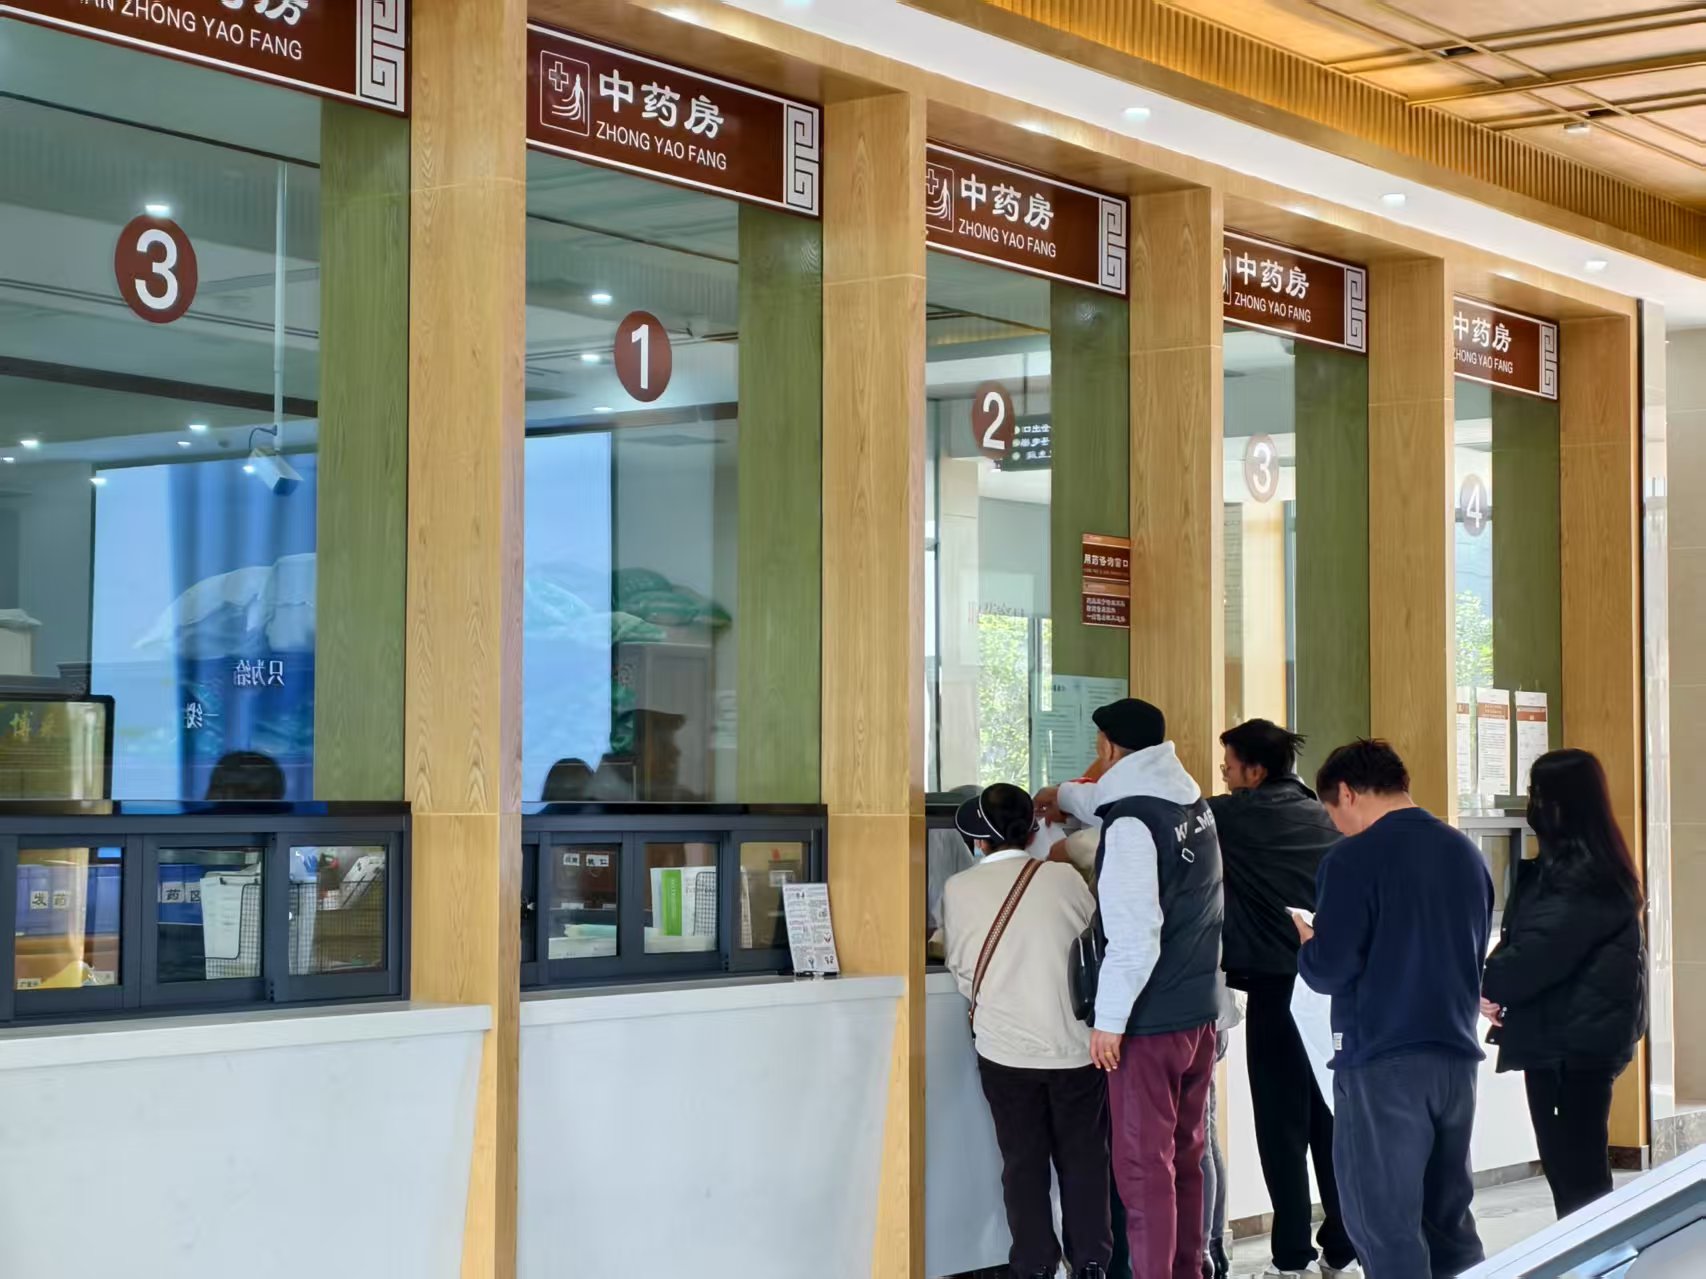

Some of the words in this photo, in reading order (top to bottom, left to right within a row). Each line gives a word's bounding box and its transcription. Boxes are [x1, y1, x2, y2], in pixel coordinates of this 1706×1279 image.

[121, 0, 196, 32] ZHONG
[202, 16, 244, 45] YAO
[250, 28, 302, 60] FANG
[599, 68, 724, 138] 中药房
[596, 120, 650, 150] ZHONG
[654, 135, 684, 159] YAO
[688, 145, 727, 170] FANG
[960, 173, 1054, 230] 中药房
[959, 218, 999, 243] ZHONG
[1001, 229, 1025, 249] YAO
[1027, 236, 1056, 258] FANG
[134, 228, 178, 310] 3
[1236, 251, 1310, 300] 中药房
[1234, 292, 1266, 312] ZHONG
[1267, 299, 1286, 317] YAO
[1288, 305, 1311, 323] FANG
[1453, 311, 1512, 353] 中药房
[631, 323, 649, 390] 1
[1453, 347, 1477, 365] HONG
[1477, 353, 1493, 369] YAO
[1494, 357, 1513, 374] FANG
[982, 391, 1006, 450] 2
[1252, 442, 1272, 494] 3
[1466, 484, 1483, 528] 4
